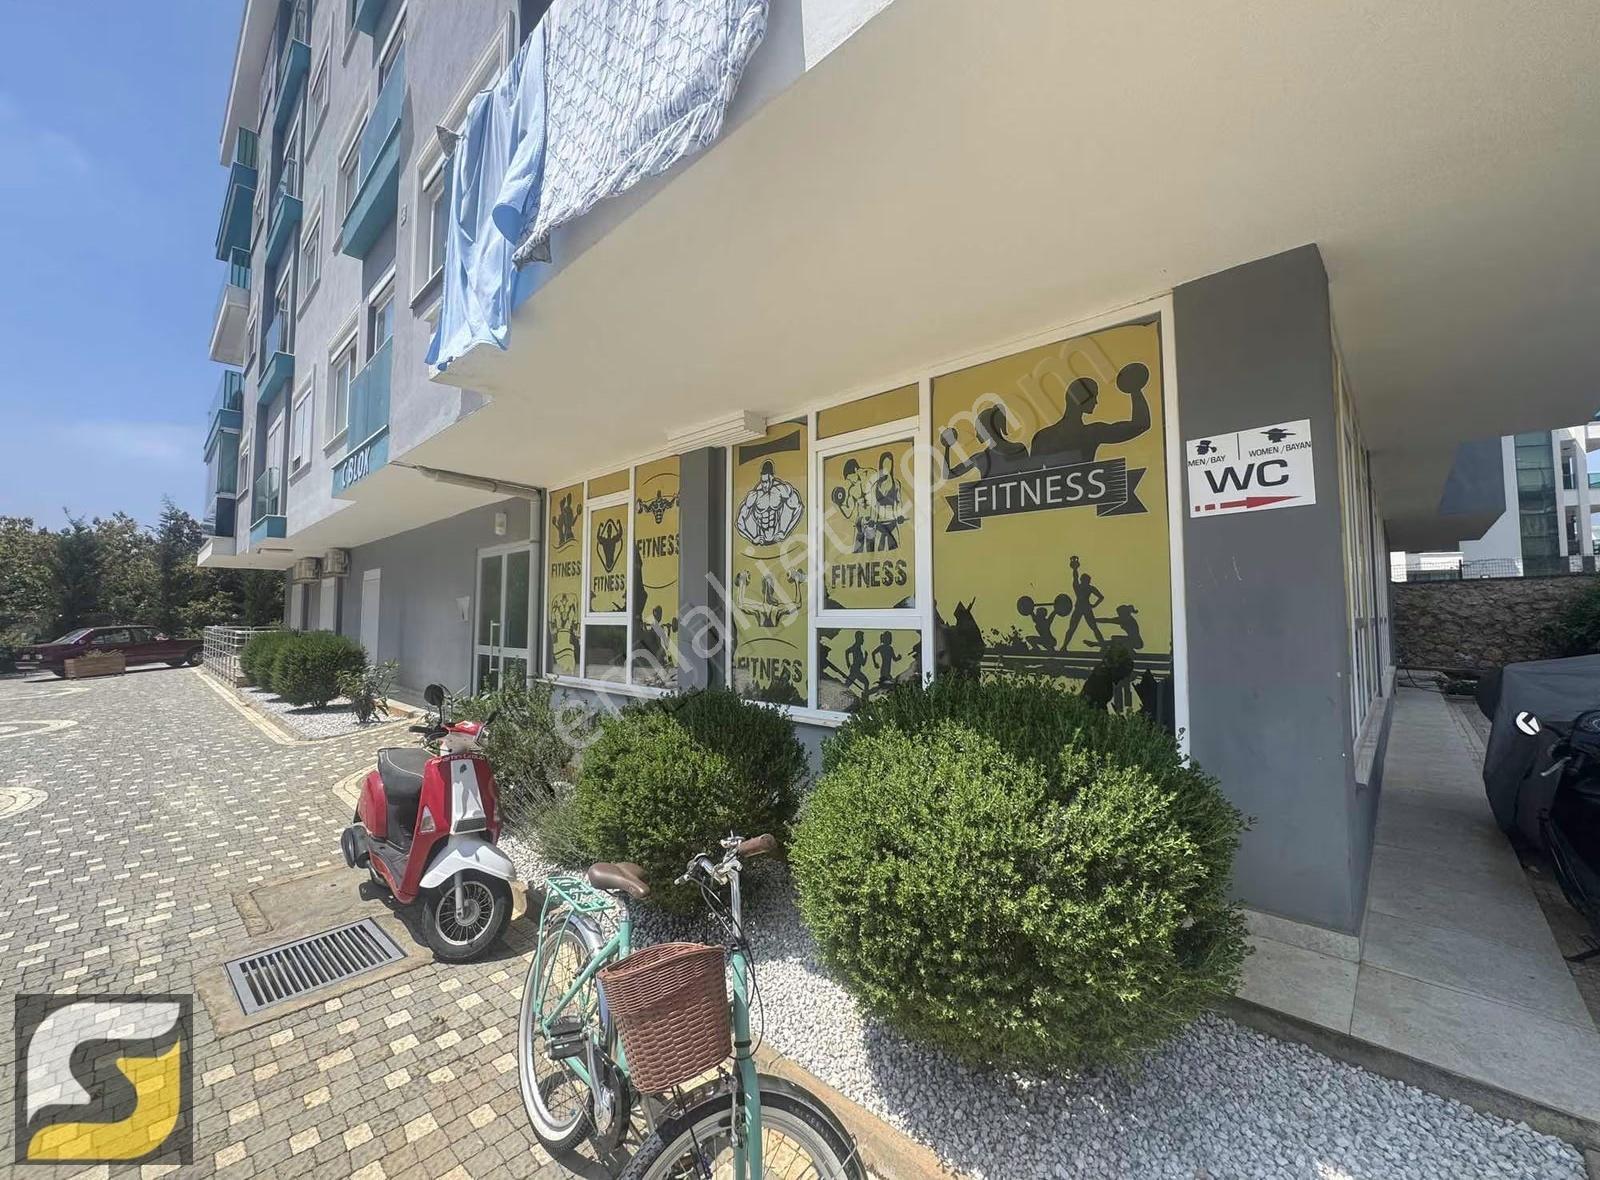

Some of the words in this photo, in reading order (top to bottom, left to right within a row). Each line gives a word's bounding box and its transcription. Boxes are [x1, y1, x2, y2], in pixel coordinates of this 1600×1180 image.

[1248, 446, 1279, 457] WOMEN
[1204, 459, 1289, 494] WC
[974, 468, 1106, 513] FITNESS
[551, 560, 582, 577] FITNESS
[831, 559, 908, 589] FITNESS
[593, 574, 625, 593] FITNESS
